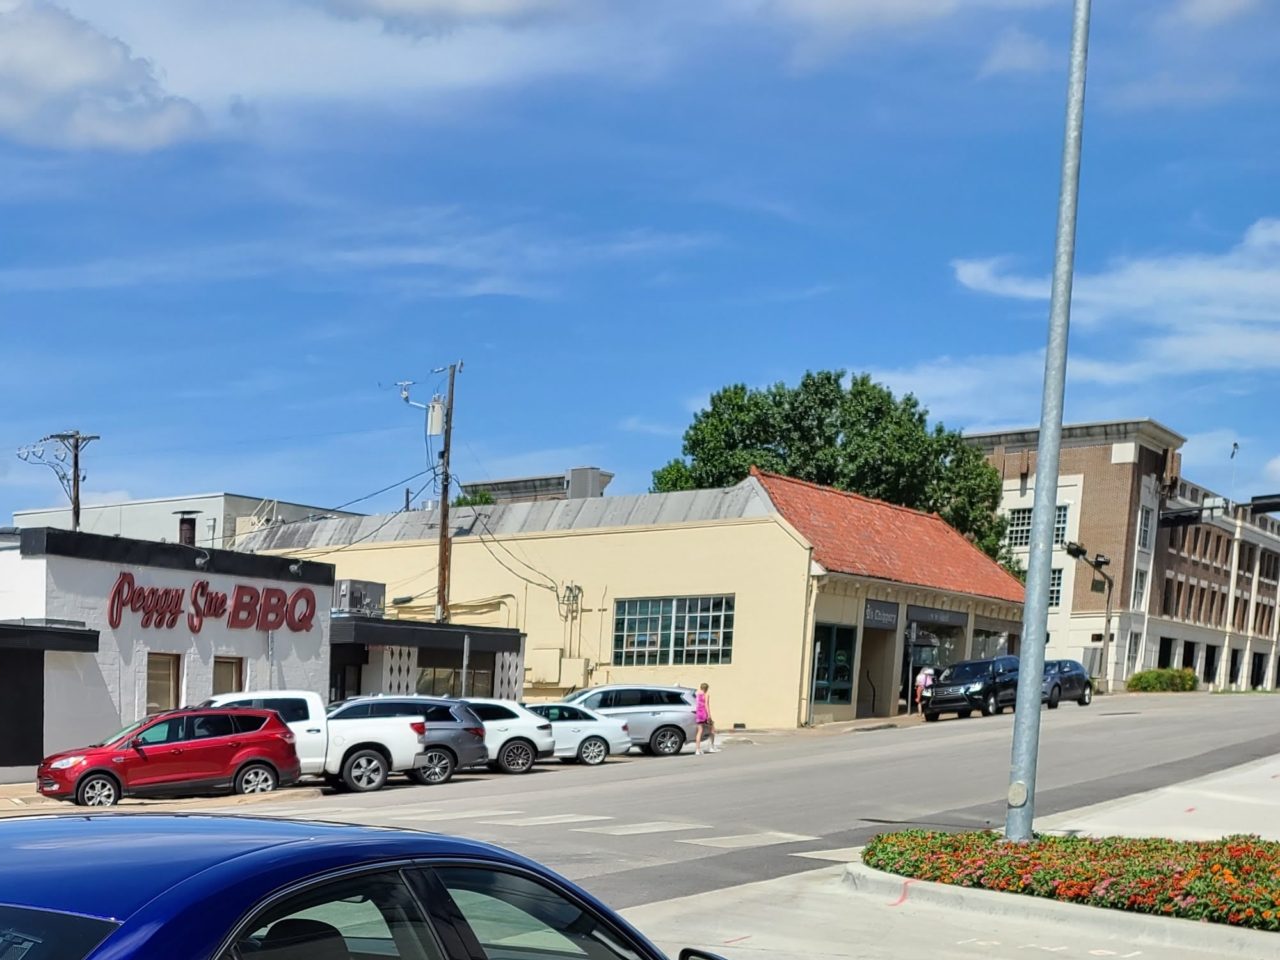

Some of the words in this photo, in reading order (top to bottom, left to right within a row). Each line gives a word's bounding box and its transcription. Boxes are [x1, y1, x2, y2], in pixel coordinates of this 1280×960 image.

[108, 571, 185, 629] Peggy
[188, 580, 227, 633] Sue
[227, 584, 316, 632] BBQ
